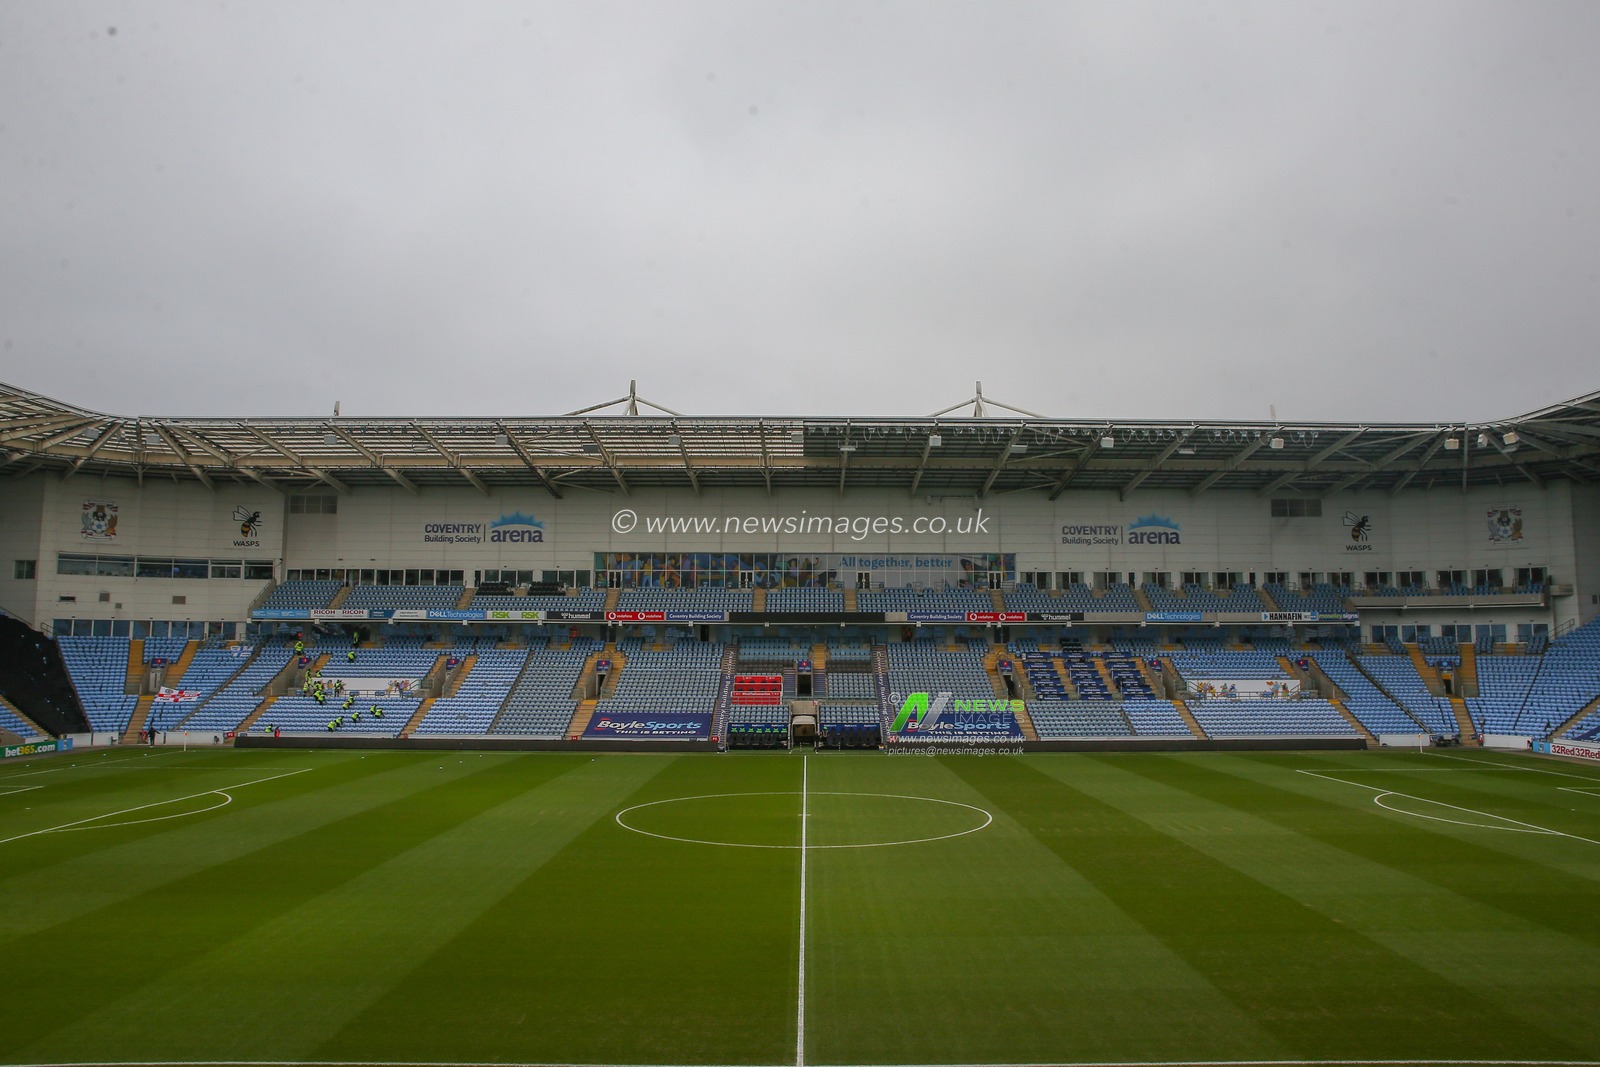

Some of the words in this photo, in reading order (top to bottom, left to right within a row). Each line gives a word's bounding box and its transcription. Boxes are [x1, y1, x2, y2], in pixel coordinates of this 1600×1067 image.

[424, 523, 482, 534] COVENTRY
[1062, 525, 1119, 536] COVENTRY
[424, 534, 454, 544] Building
[455, 534, 482, 544] Society
[490, 529, 544, 543] arena
[1128, 531, 1182, 545] arena
[233, 540, 260, 548] WASPS
[1062, 537, 1092, 546] Building
[1093, 537, 1119, 546] Society
[839, 556, 856, 567] All
[858, 556, 913, 570] together,
[915, 556, 953, 568] better
[447, 611, 484, 619] Technologies
[491, 611, 510, 619] RSK
[521, 611, 540, 619] RSK
[1269, 612, 1302, 621] HANNAFIN
[1343, 612, 1359, 620] signs
[597, 720, 702, 730] BoyleSports
[5, 743, 56, 758] bet365.com
[1551, 744, 1575, 756] 32Red
[1576, 747, 1600, 759] 32Red
